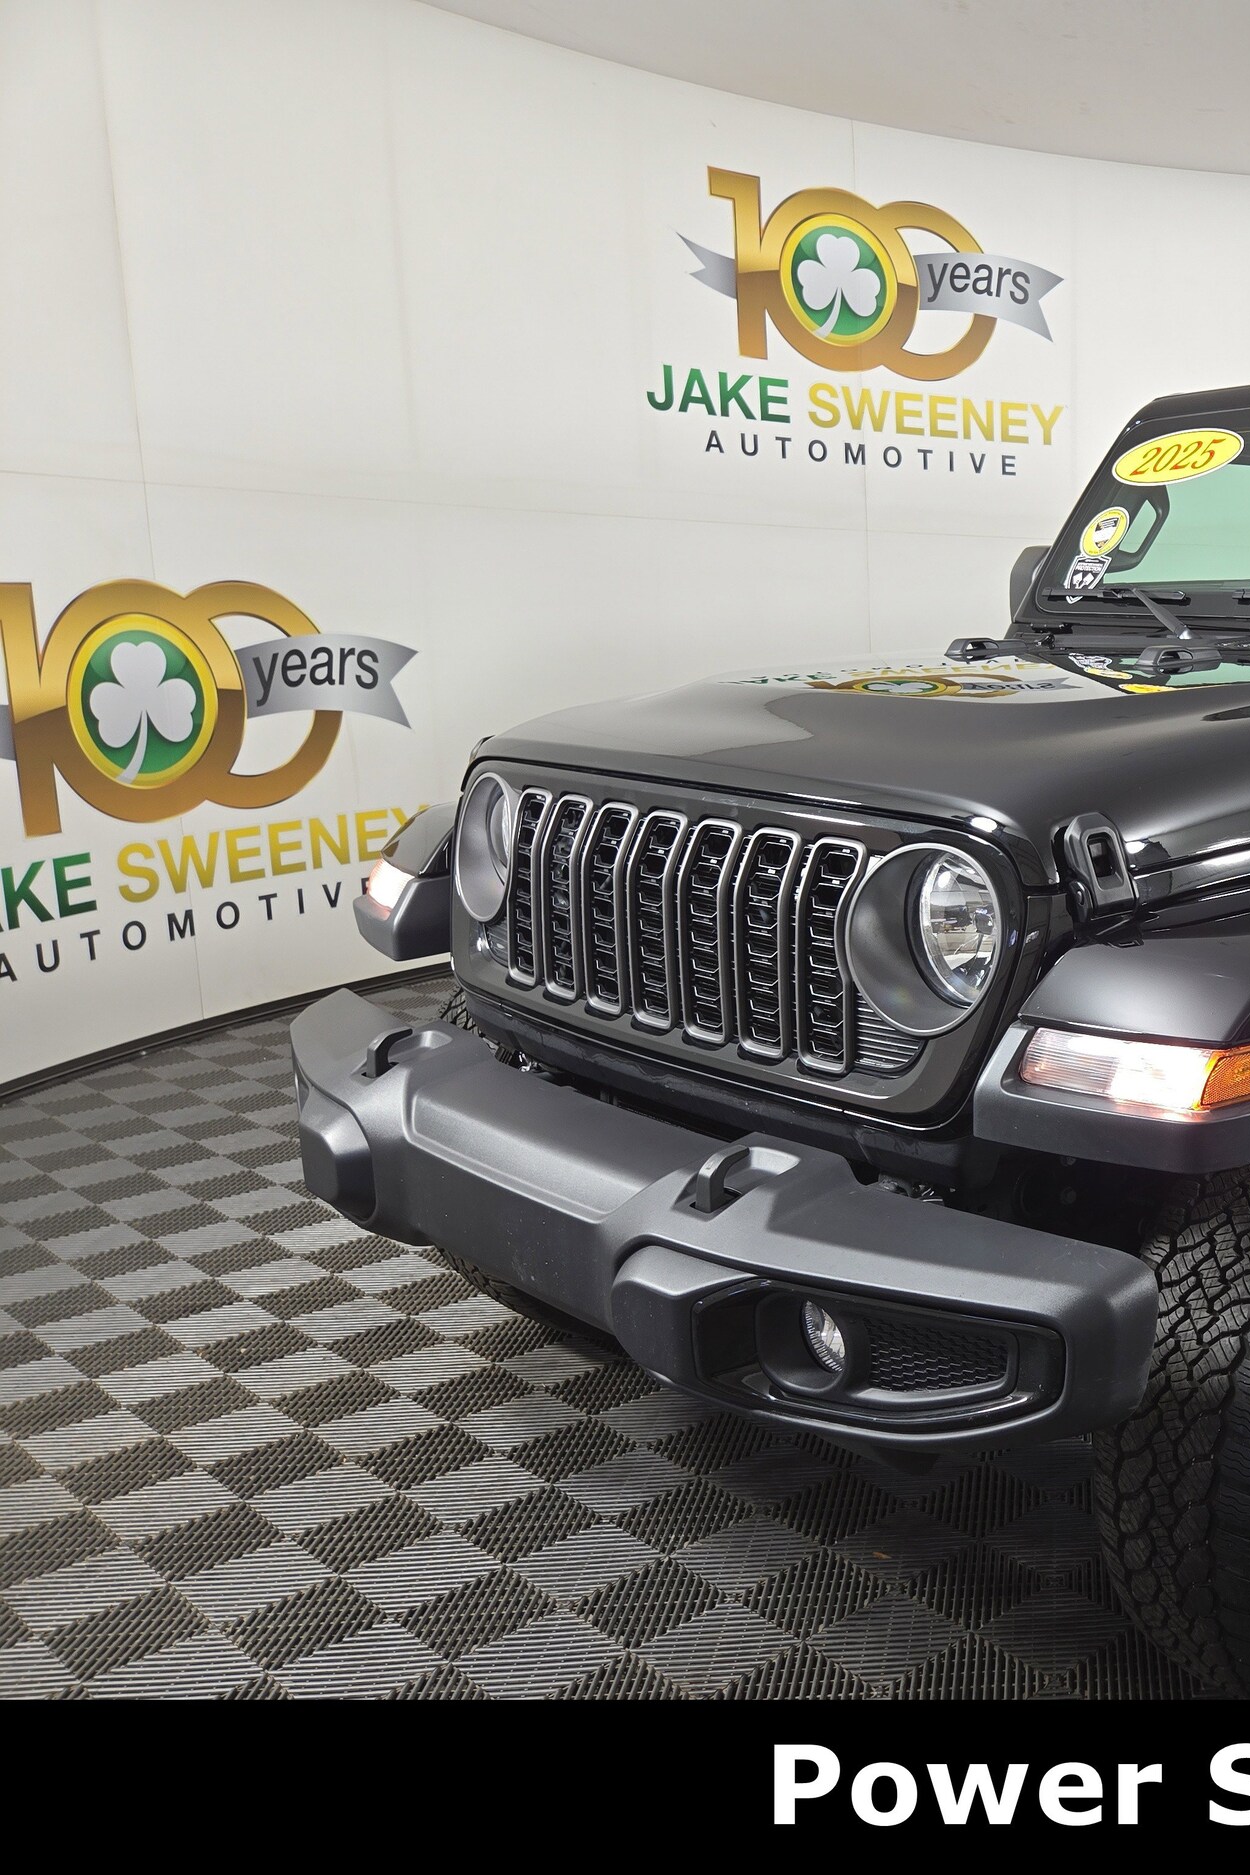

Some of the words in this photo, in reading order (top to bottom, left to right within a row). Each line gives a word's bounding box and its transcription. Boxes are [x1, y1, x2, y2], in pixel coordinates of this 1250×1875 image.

[707, 166, 998, 381] 100
[927, 260, 1030, 305] years
[646, 364, 791, 424] JAKE
[808, 382, 1065, 446] SWEENEY
[705, 430, 1017, 476] AUTOMOTIVE
[1129, 438, 1229, 477] 2025
[252, 646, 380, 707] years
[0, 852, 98, 932] KE
[0, 876, 370, 982] AUTOMOTIV
